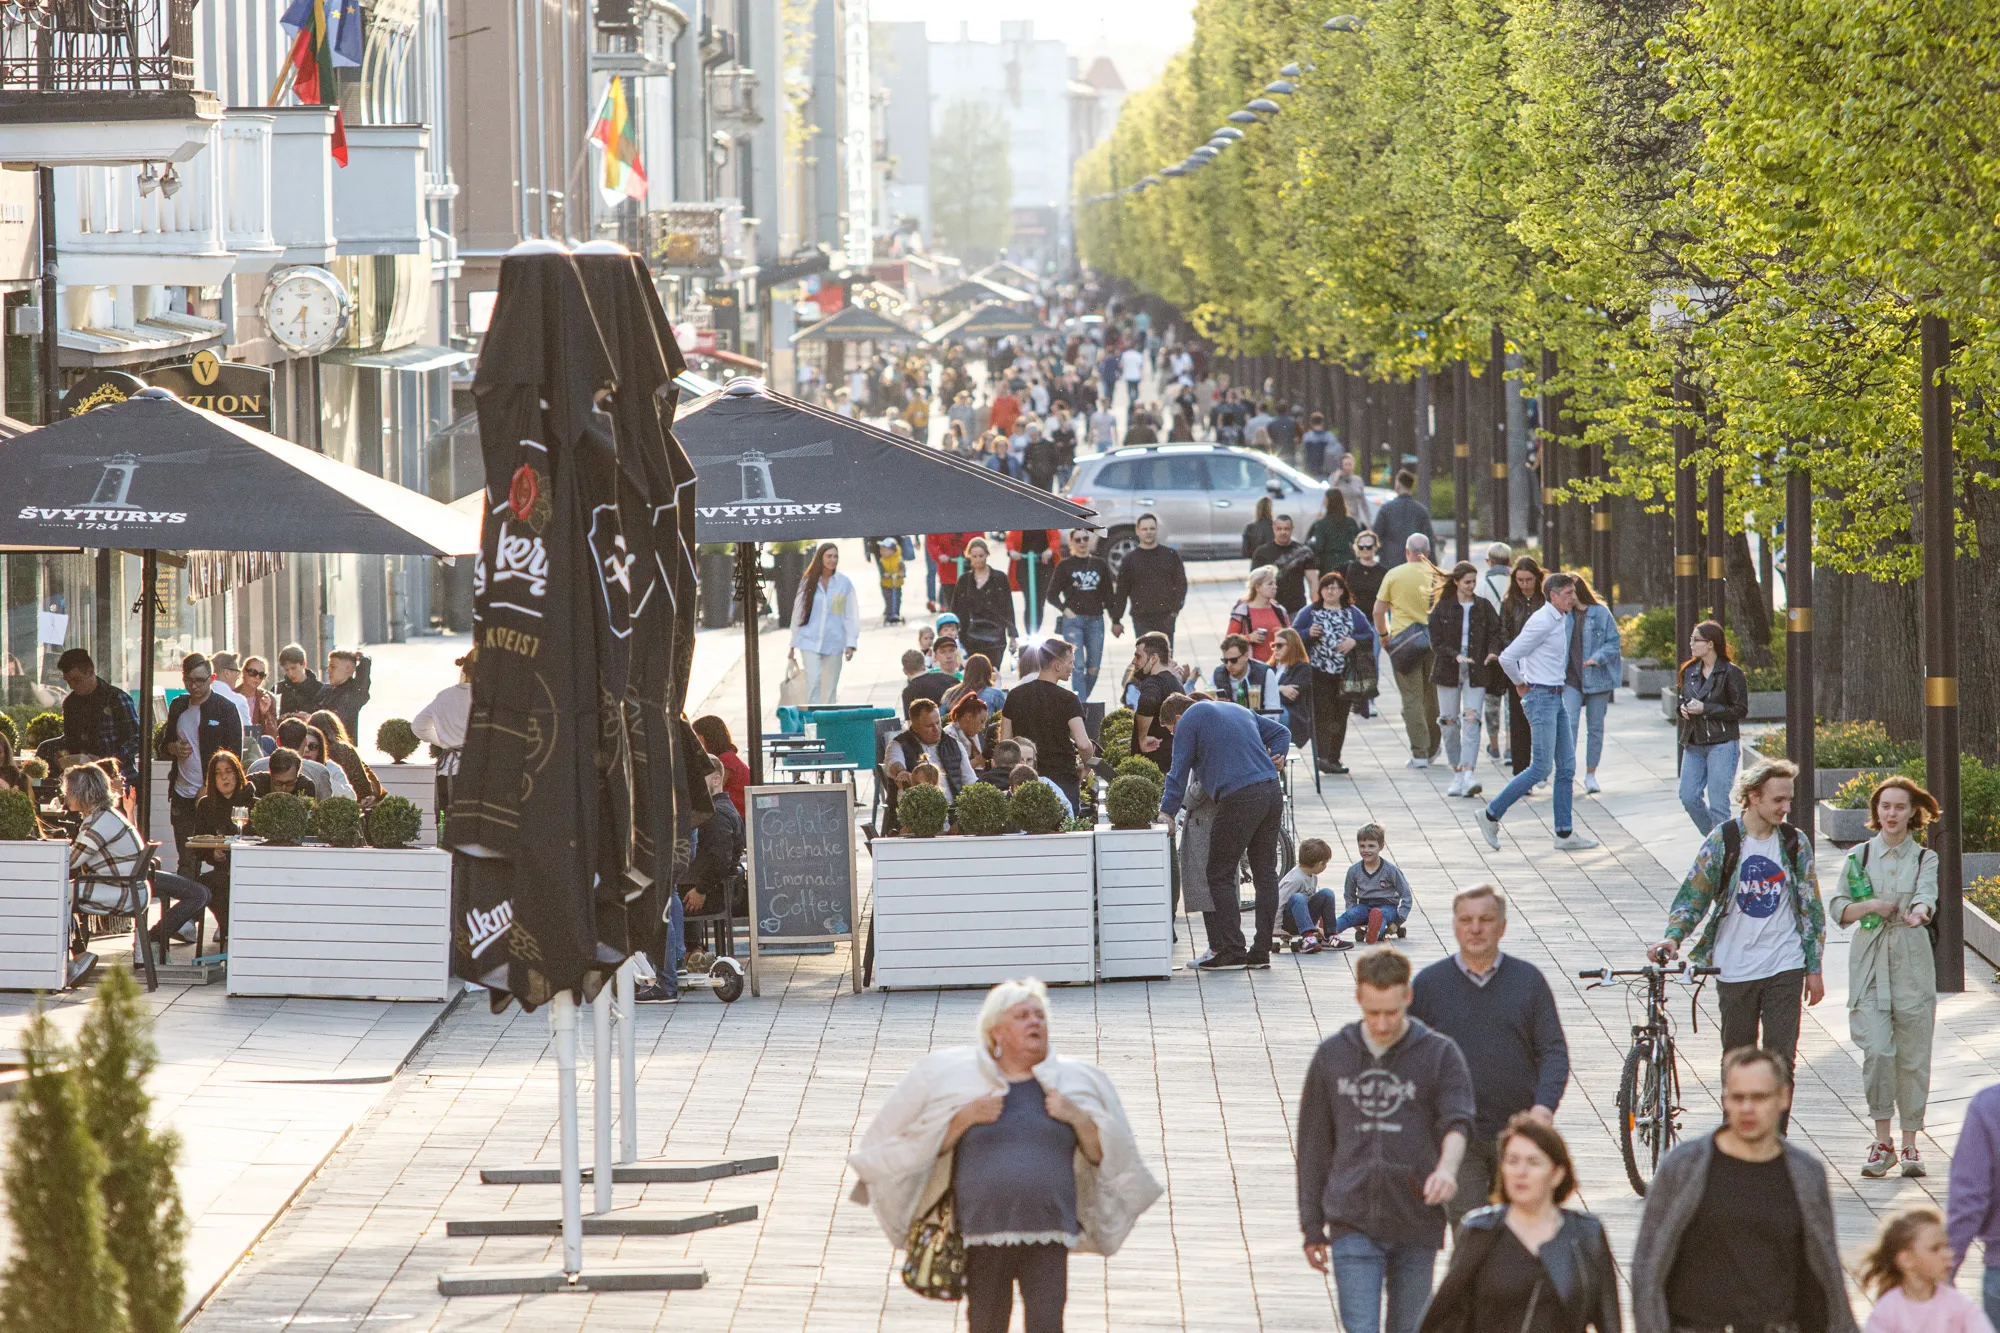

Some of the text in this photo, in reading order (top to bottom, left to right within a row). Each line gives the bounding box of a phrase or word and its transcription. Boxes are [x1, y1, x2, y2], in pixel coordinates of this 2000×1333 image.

[275, 307, 283, 316] 9
[323, 307, 331, 315] 3
[197, 360, 213, 382] V
[178, 394, 261, 413] ZION
[17, 505, 188, 524] ŠVYTURYS
[741, 516, 785, 526] 1784
[76, 521, 119, 531] 1784
[760, 803, 842, 836] Gelato
[761, 835, 844, 862] Milkshake
[763, 863, 844, 890] Limonade
[1738, 879, 1782, 895] NASA
[769, 889, 843, 924] Coffee
